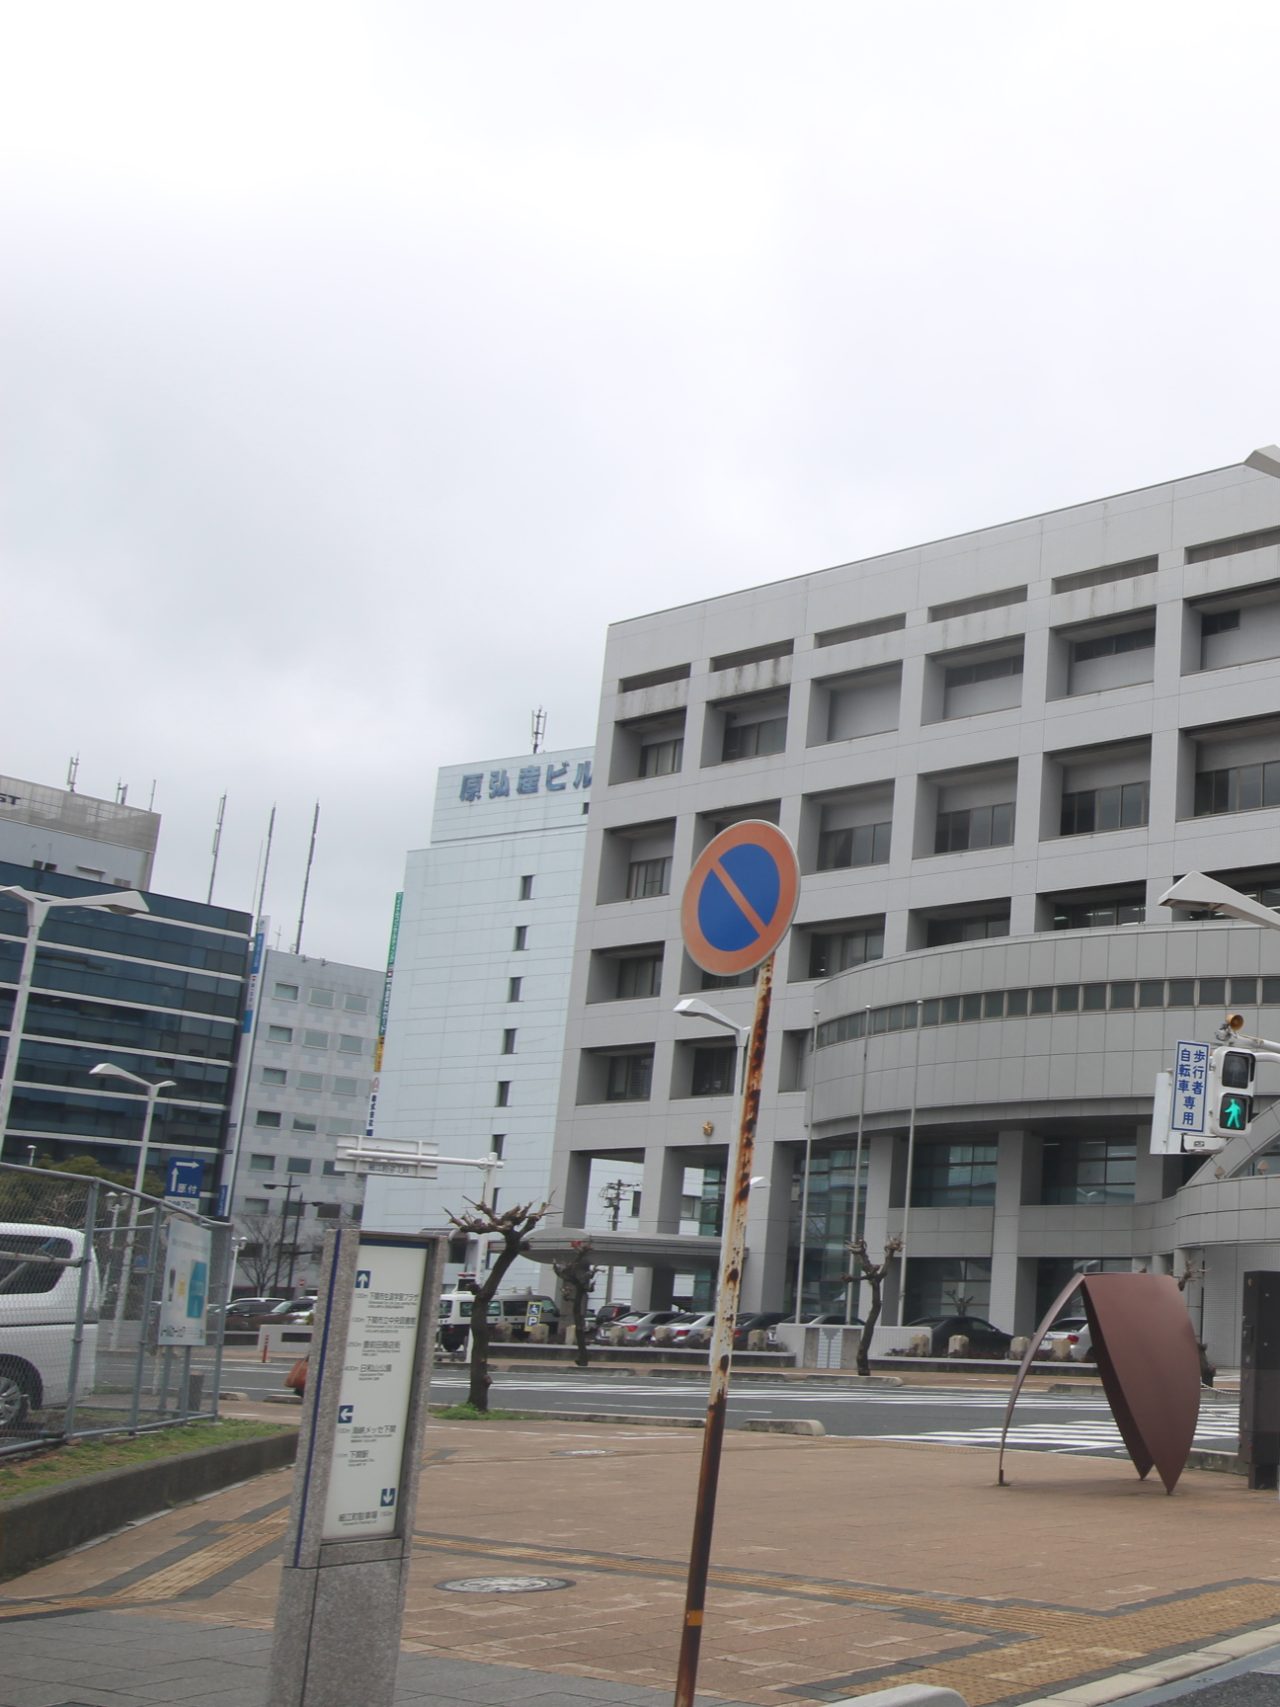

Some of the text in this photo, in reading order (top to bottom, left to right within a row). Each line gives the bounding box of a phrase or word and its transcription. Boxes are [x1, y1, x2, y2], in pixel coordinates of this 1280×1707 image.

[459, 760, 593, 803] 原弘産ビル
[1177, 1049, 1190, 1093] 自転車
[1191, 1050, 1205, 1095] 歩行者
[1182, 1096, 1195, 1125] 専用
